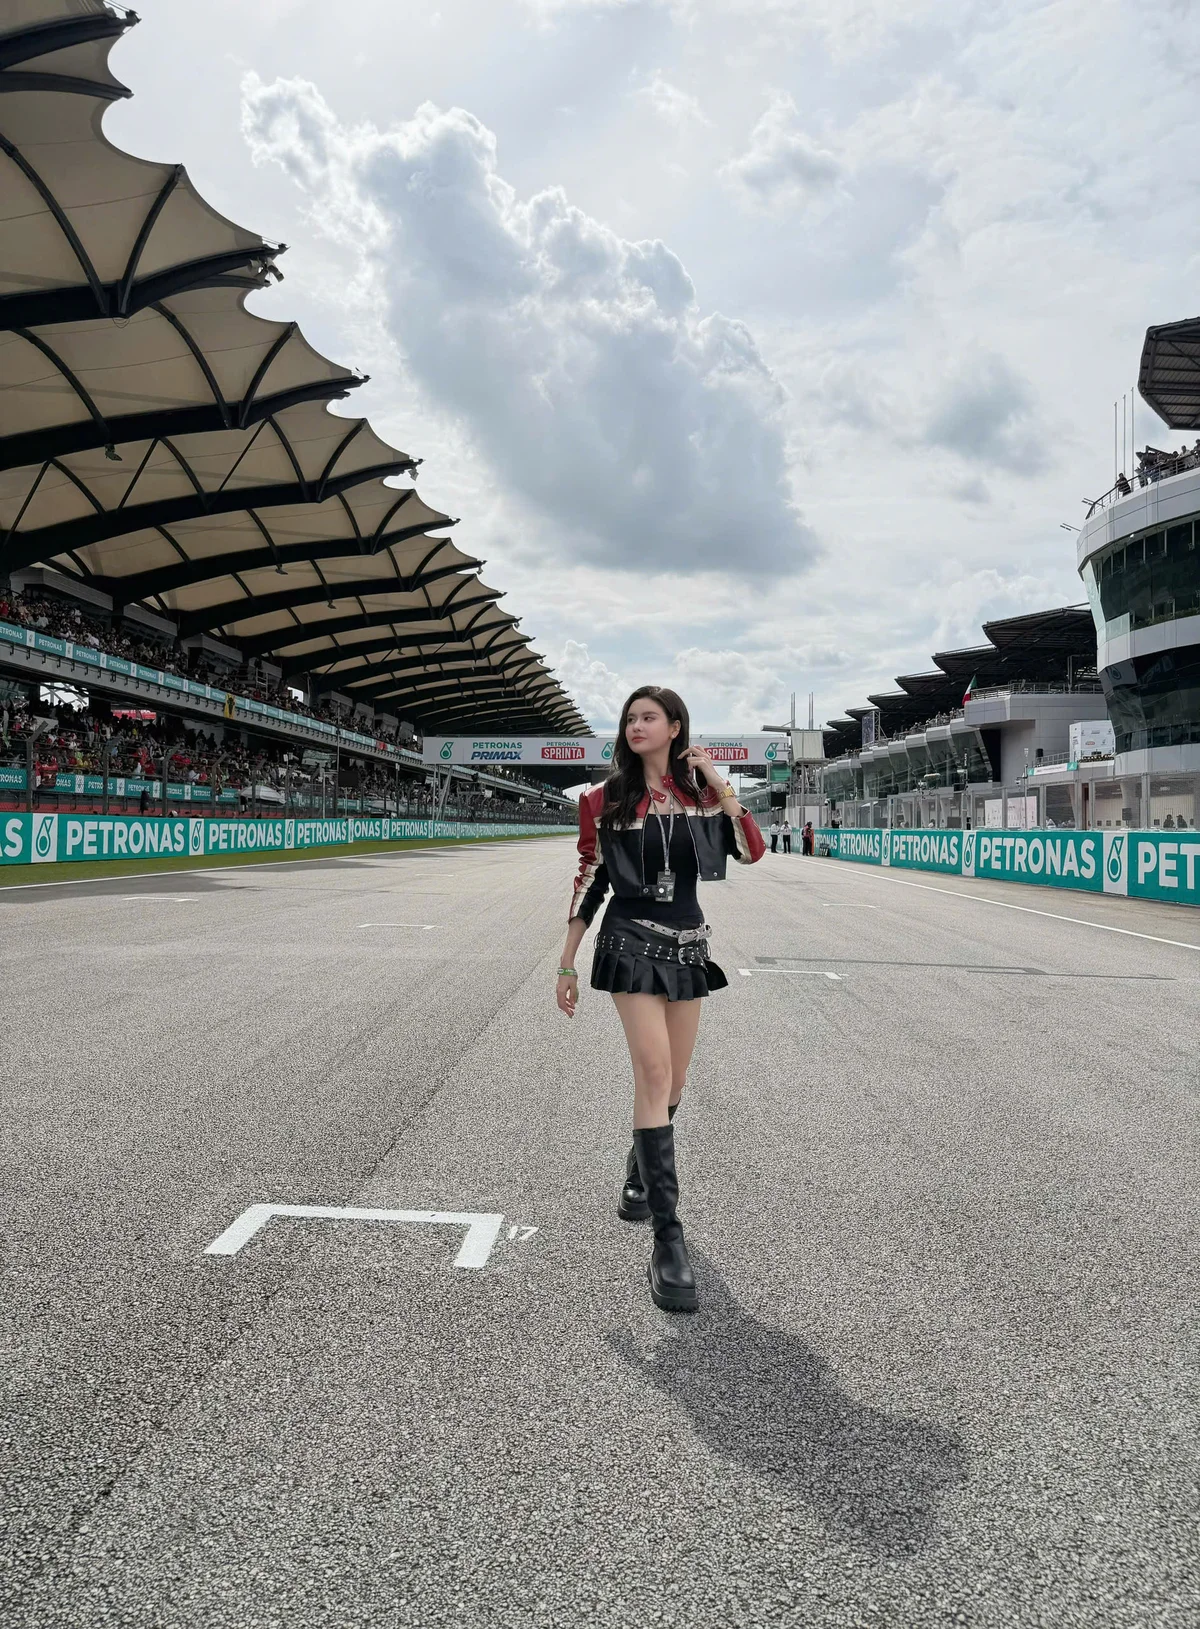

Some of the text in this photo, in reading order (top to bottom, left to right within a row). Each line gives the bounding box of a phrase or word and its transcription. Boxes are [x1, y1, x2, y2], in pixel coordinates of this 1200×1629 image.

[39, 638, 62, 651] PETRONAS
[76, 650, 97, 661] PETRONAS
[472, 741, 523, 749] PETRONAS
[471, 751, 523, 760] PRIMAX
[543, 748, 583, 759] SPRINTA
[707, 748, 745, 760] SPRINTA
[209, 822, 282, 850] PETRONAS
[297, 821, 346, 844] PETRONAS
[391, 821, 427, 837] PETRONAS
[434, 822, 457, 837] PETRONAS
[66, 821, 185, 856] PETRONAS
[840, 833, 880, 858] PETRONAS
[893, 835, 959, 866] PETRONAS
[979, 837, 1096, 879] PETRONAS
[1137, 841, 1200, 890] PET
[509, 1226, 539, 1240] 17
